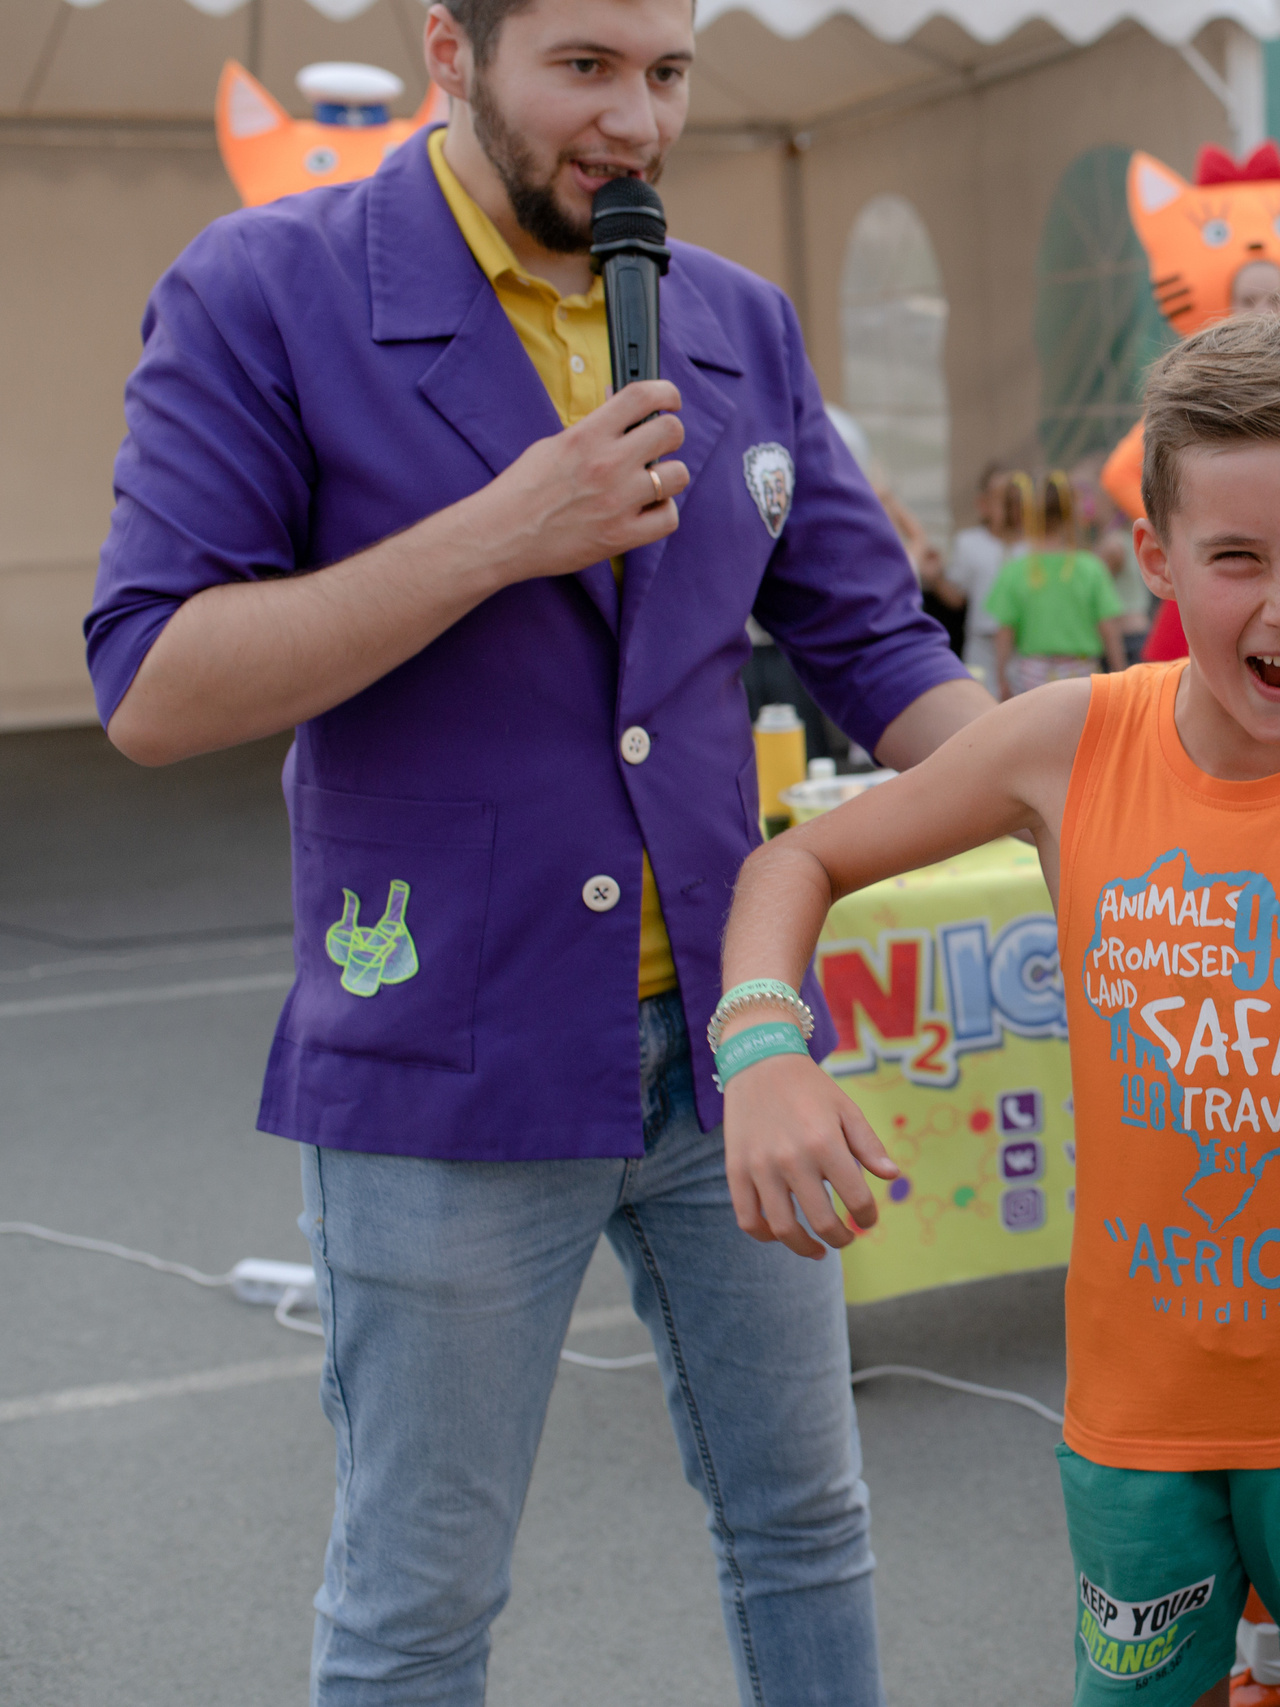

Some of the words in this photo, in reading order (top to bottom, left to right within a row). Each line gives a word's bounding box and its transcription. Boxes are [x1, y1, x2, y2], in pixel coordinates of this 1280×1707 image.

[1102, 884, 1242, 928] ANIMALS
[1093, 936, 1239, 978] PROMISED
[1086, 971, 1138, 1008] LAND
[1081, 1577, 1118, 1628] KEEP
[1131, 1584, 1210, 1636] YOUR
